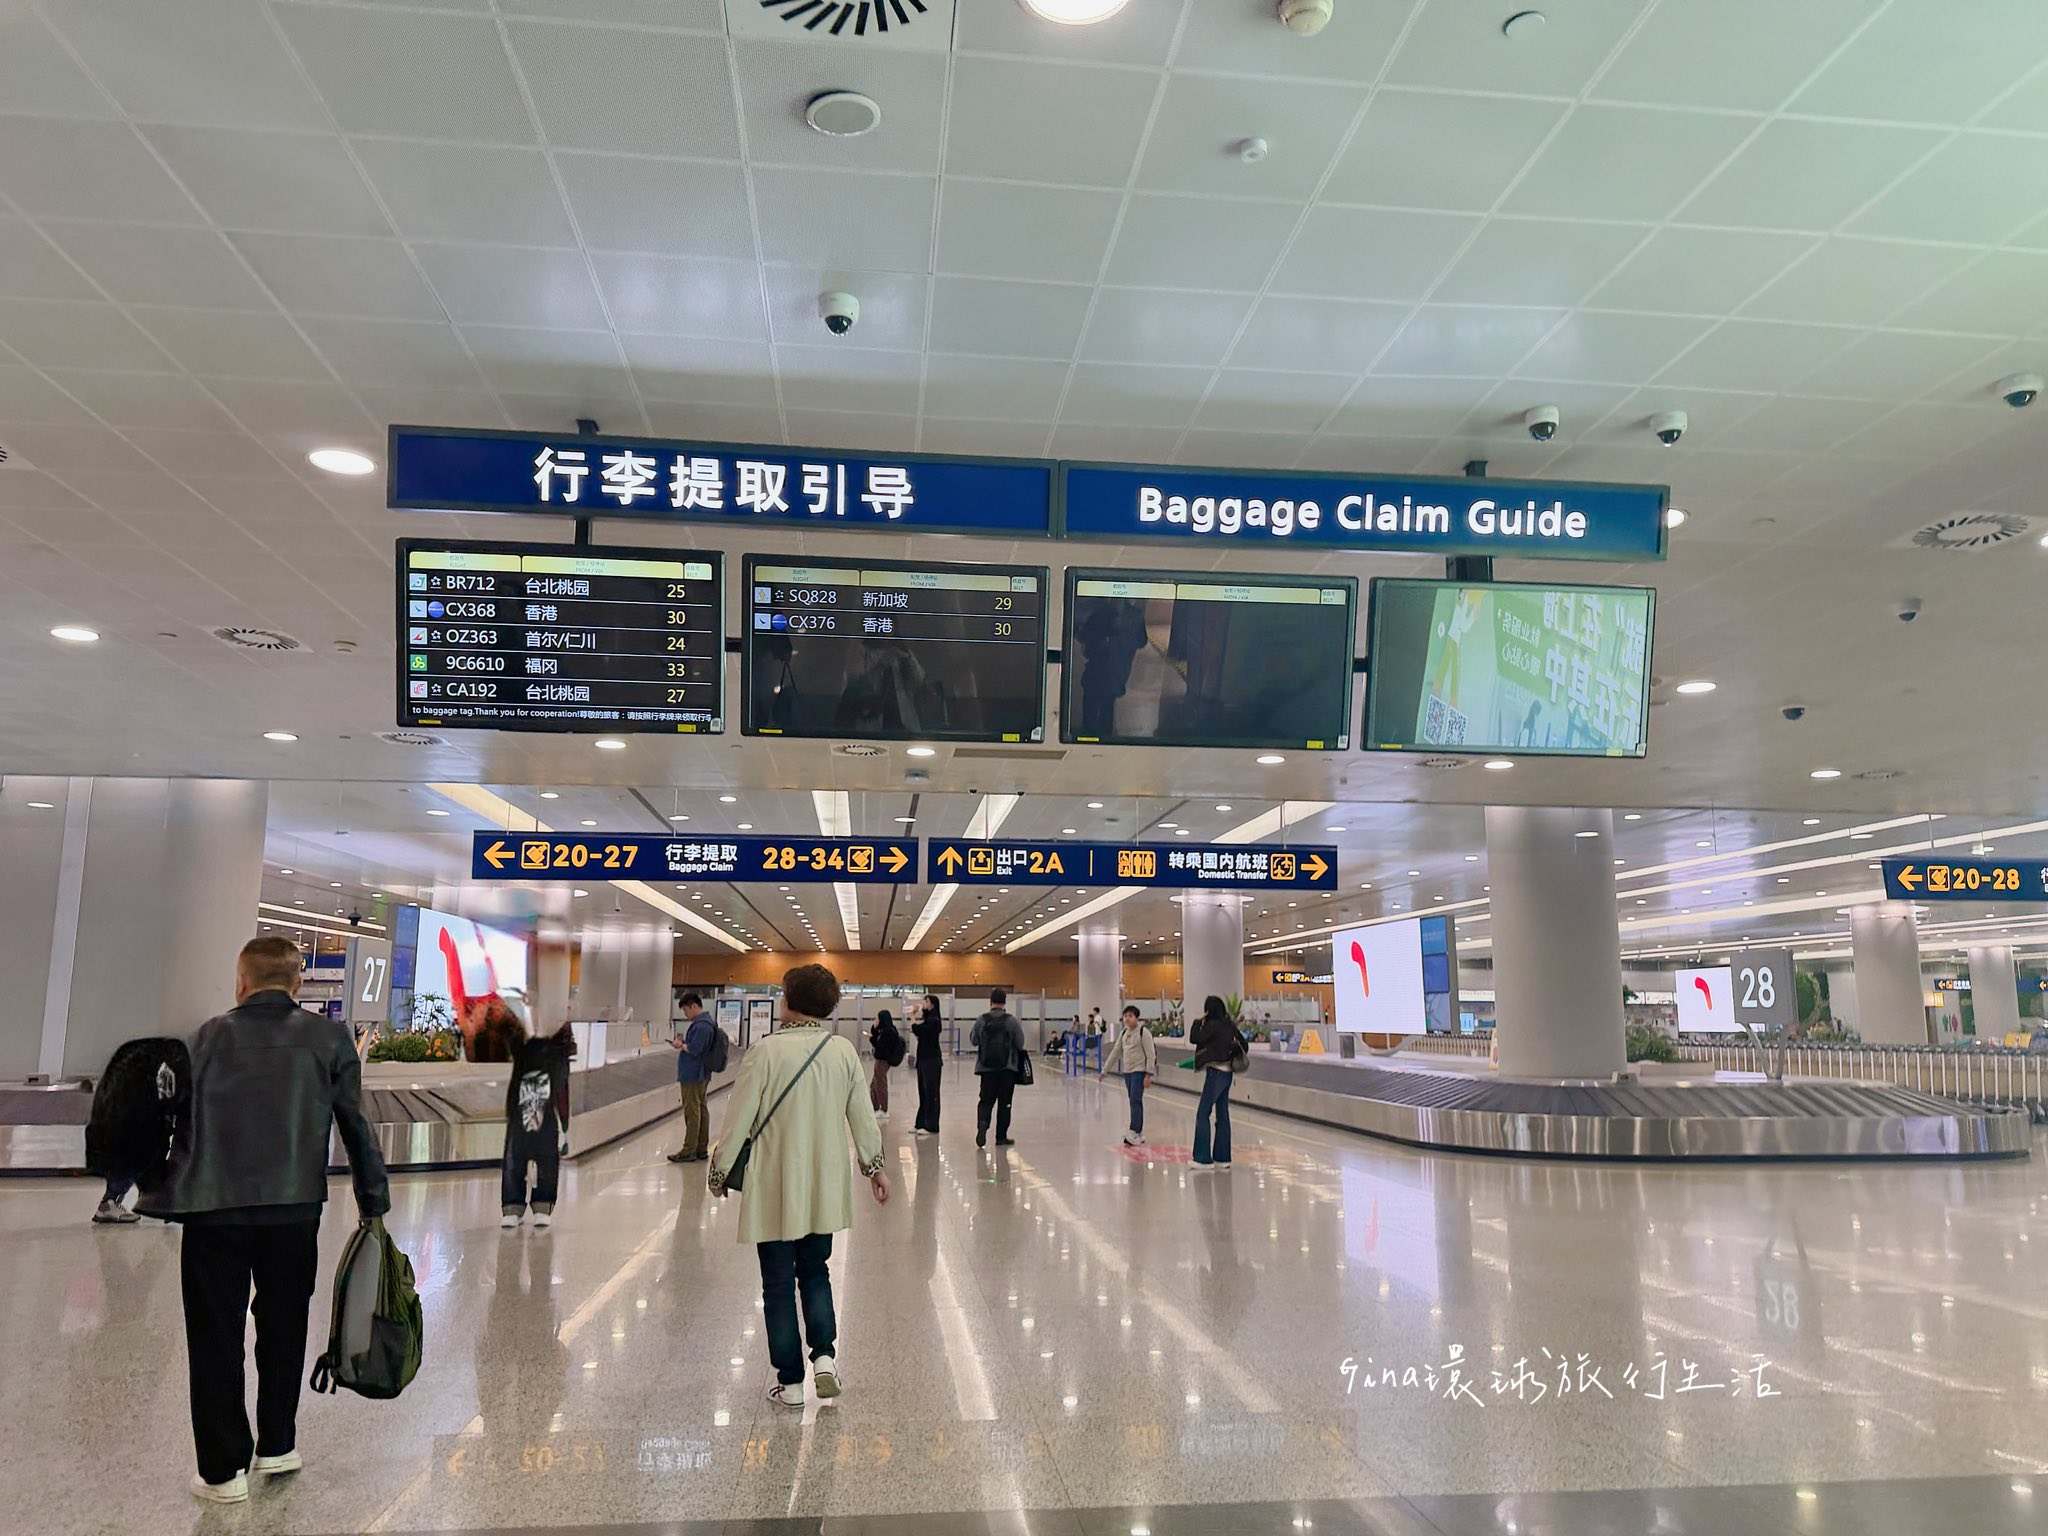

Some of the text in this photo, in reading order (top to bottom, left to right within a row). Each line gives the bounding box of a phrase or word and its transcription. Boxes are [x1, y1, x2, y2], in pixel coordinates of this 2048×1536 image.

[534, 447, 914, 519] 行李提取引导
[1139, 487, 1586, 537] Baggage Claim Guide
[446, 575, 685, 598] BR712 台北桃园 25
[789, 589, 1012, 610] SQ828 新加坡 29
[446, 602, 686, 625] CX368 香港 30
[789, 615, 1012, 636] CX376 香港 30
[446, 628, 685, 650] OZ363 首尔/仁川 24
[446, 655, 685, 677] 9C6610 福冈 33
[446, 682, 685, 703] CA192 台北桃园 27
[423, 706, 458, 716] baggage
[517, 708, 529, 716] for
[553, 844, 638, 869] 20-27
[665, 843, 738, 861] 行李提取
[763, 847, 844, 871] 28-34
[997, 848, 1064, 874] 出口 2A
[1169, 851, 1268, 870] 转乘国内航班
[669, 861, 734, 873] Baggage Claim
[996, 866, 1013, 875] Exit
[1198, 870, 1268, 879] Domestic Transfer
[1952, 868, 2020, 890] 20-28
[362, 956, 387, 1003] 27
[1740, 966, 1776, 1008] 28
